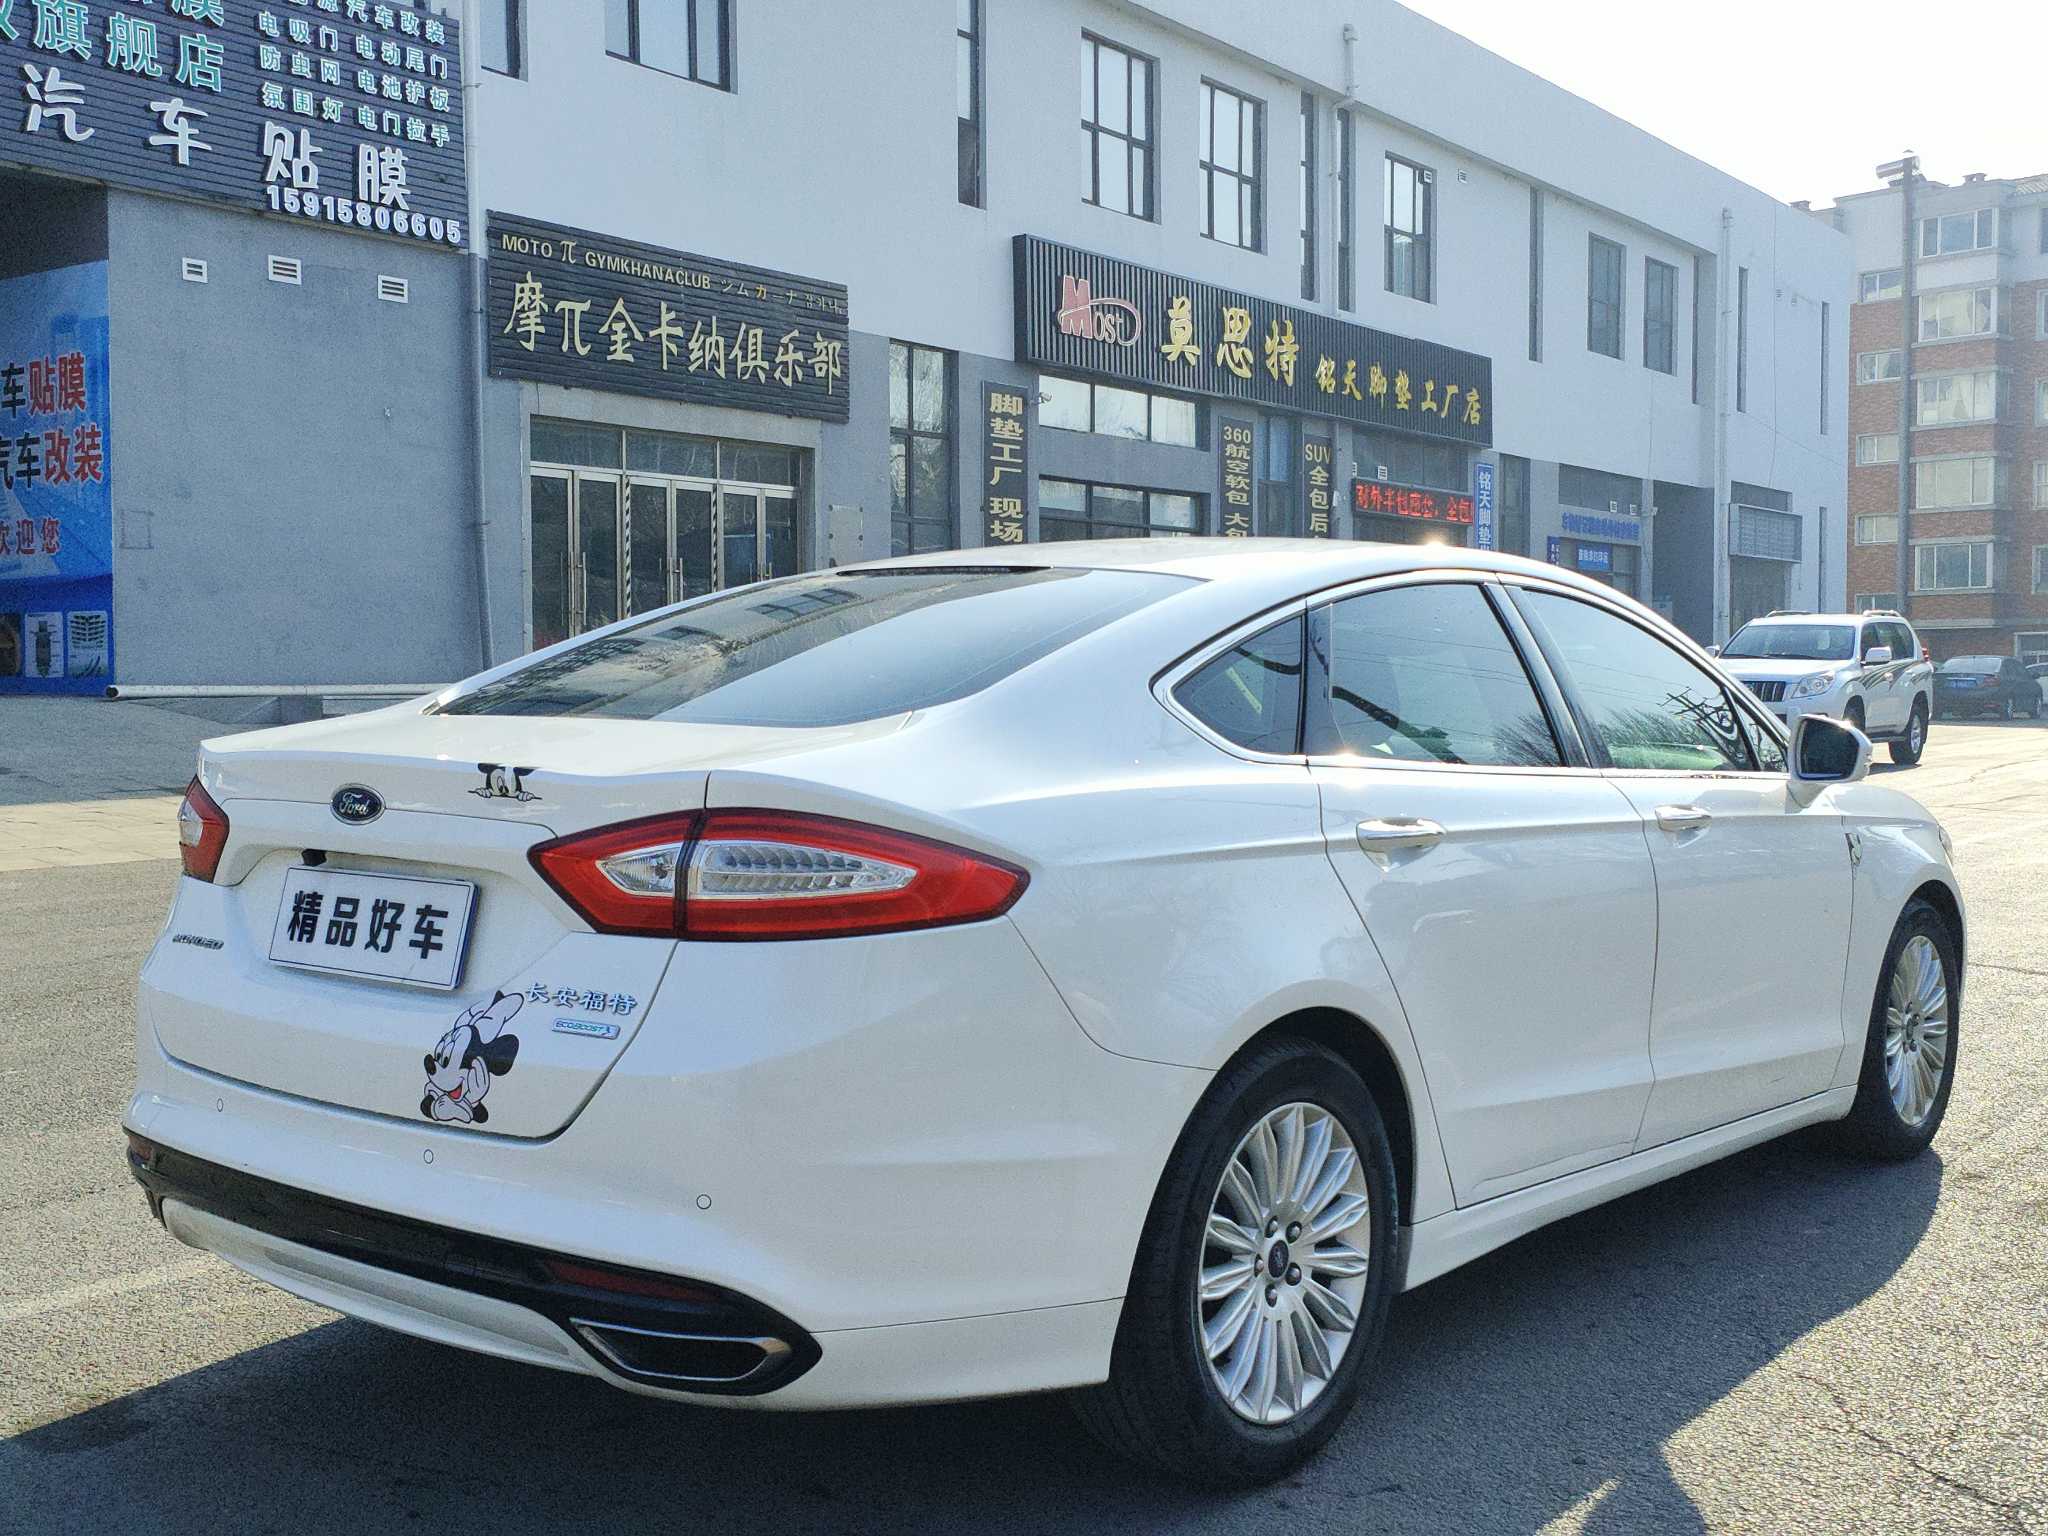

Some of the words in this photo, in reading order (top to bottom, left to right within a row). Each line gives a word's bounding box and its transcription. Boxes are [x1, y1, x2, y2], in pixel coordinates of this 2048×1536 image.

[258, 11, 339, 51] 电吸门
[355, 34, 448, 79] 电动尾门
[259, 44, 341, 86] 防虫网
[357, 69, 450, 112] 电池护板
[261, 82, 344, 123] 氛围灯
[357, 106, 450, 147] 电门拉手
[266, 185, 461, 243] 15915806605
[502, 233, 553, 259] MOTO
[584, 251, 712, 290] GYMKHANACLUB
[1160, 295, 1300, 387] 莫思特
[989, 391, 1024, 486] 脚垫工厂
[1223, 425, 1252, 444] 360
[1304, 443, 1331, 464] SUV
[1224, 443, 1251, 506] 航空软包
[989, 496, 1024, 543] 现场
[338, 791, 370, 816] Ford
[286, 890, 449, 960] 精品好车
[525, 981, 638, 1015] 长安福特
[555, 1020, 604, 1033] ECOBOOST
